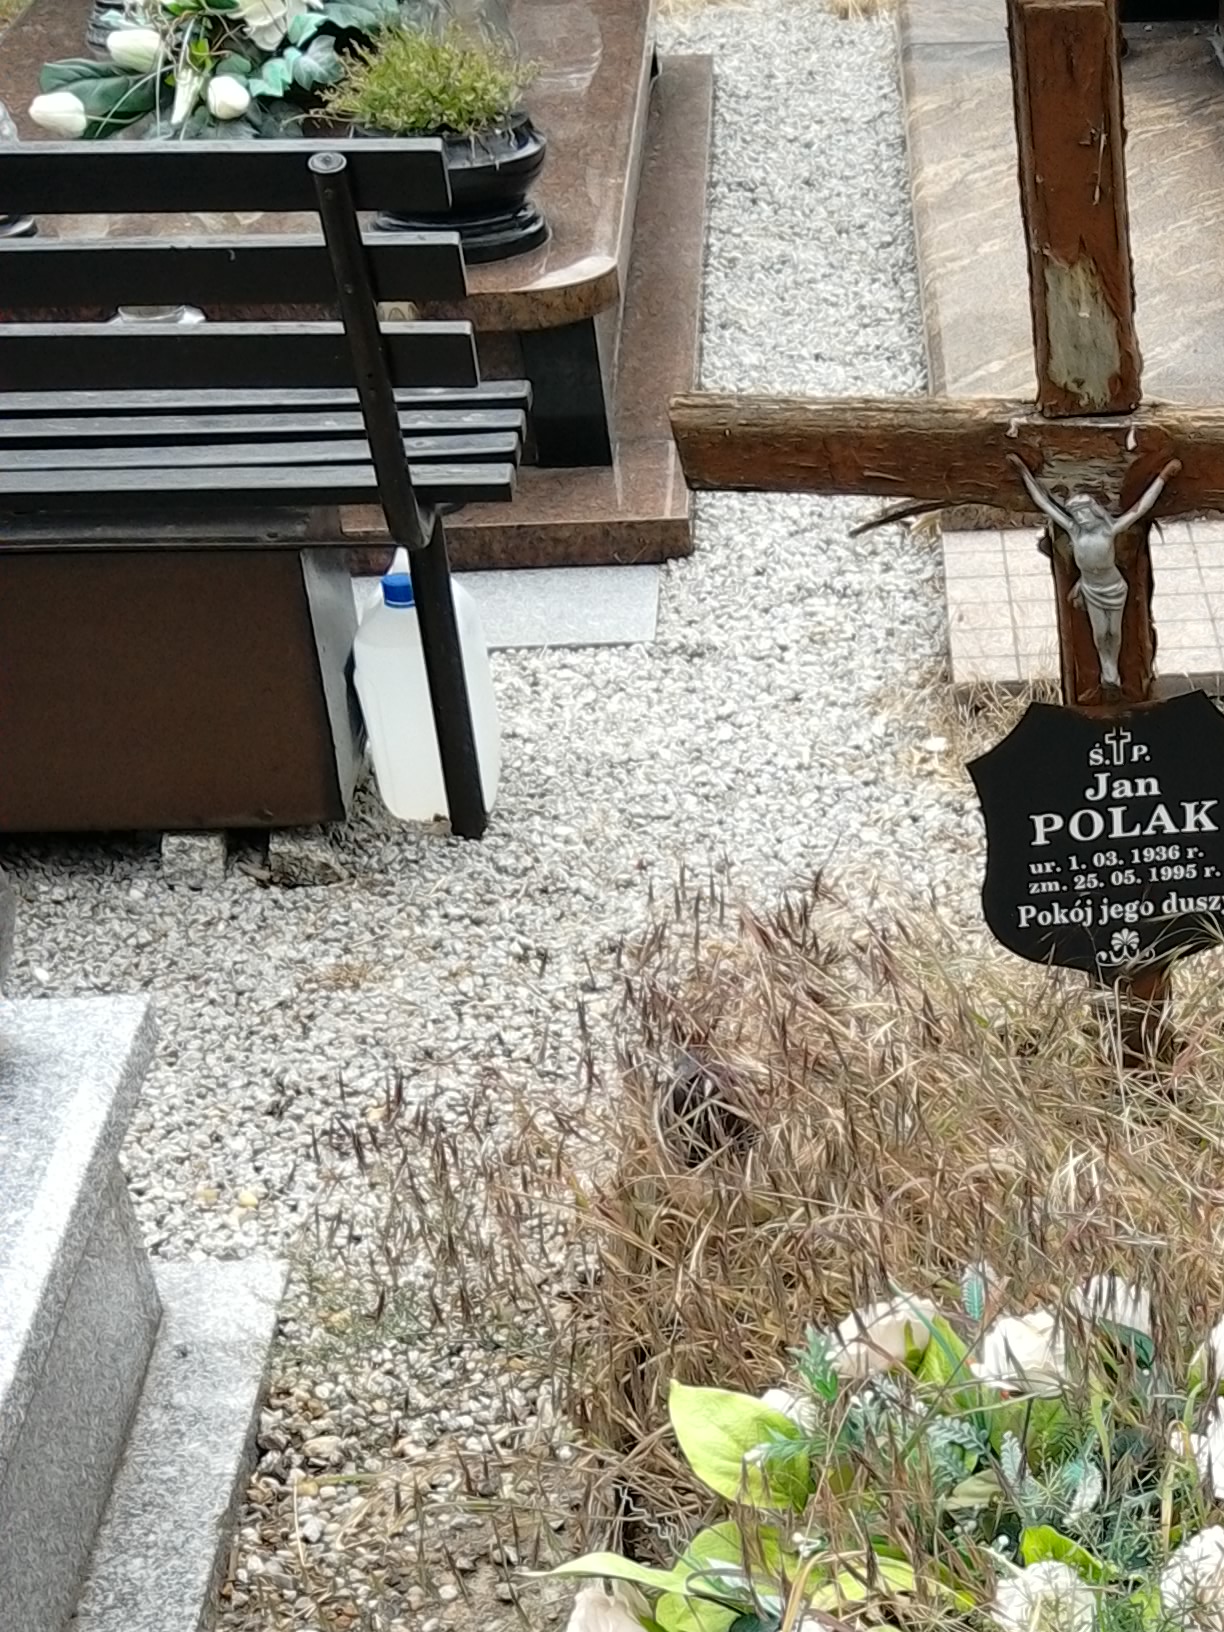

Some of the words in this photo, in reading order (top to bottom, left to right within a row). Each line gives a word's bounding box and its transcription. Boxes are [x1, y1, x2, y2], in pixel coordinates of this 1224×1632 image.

[1085, 773, 1161, 800] Jan
[1029, 800, 1218, 846] POLAK
[1029, 862, 1061, 874] ur.
[1069, 856, 1086, 870] 1.
[1093, 851, 1123, 867] 03.
[1132, 845, 1180, 863] 1936
[1187, 848, 1203, 858] r.
[1029, 882, 1067, 894] zm.
[1074, 874, 1104, 889] 25.
[1111, 870, 1141, 885] 05.
[1150, 864, 1197, 881] 1995
[1204, 867, 1220, 877] r.
[1017, 899, 1093, 928] Pokój
[1099, 898, 1154, 924] jego
